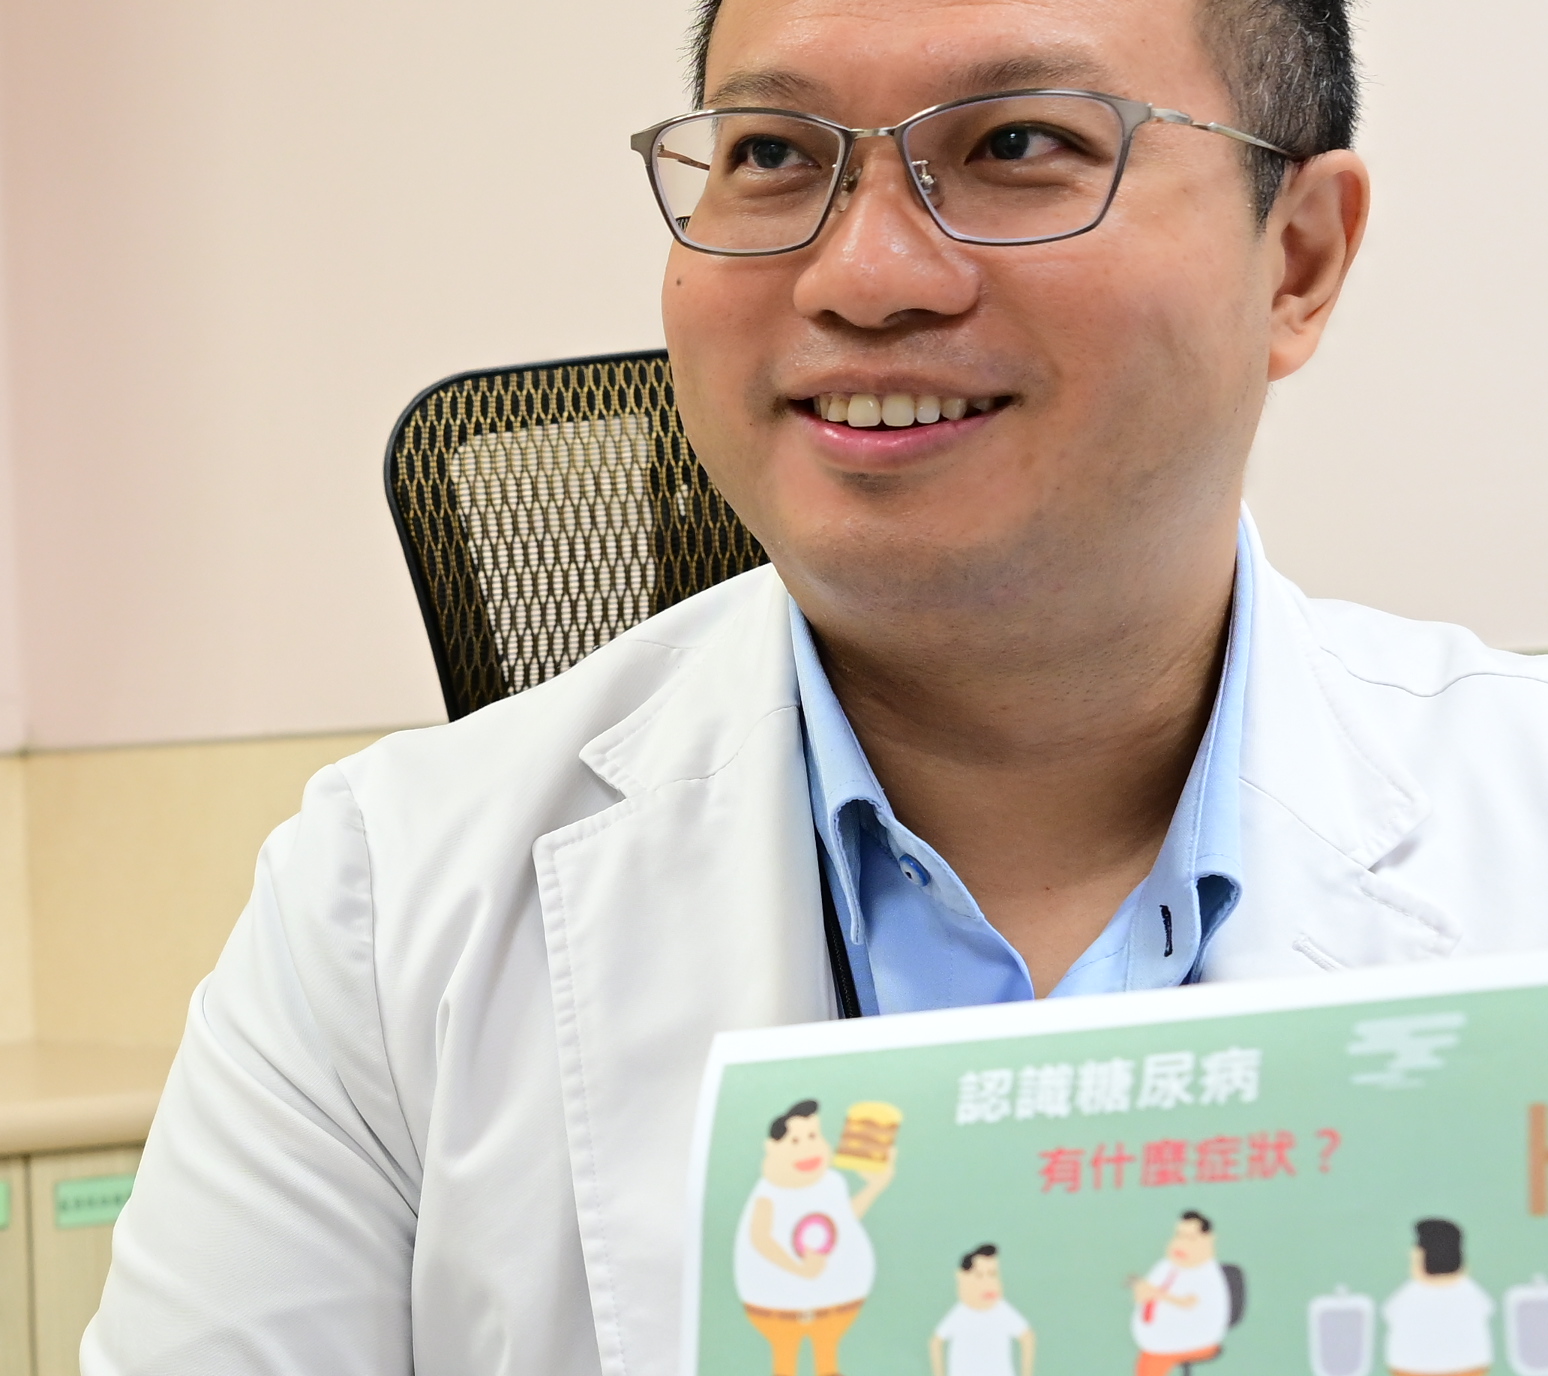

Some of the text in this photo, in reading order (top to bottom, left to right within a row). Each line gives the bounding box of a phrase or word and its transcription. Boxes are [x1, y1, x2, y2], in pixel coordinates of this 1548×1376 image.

[955, 1048, 1262, 1125] 認識糖尿病
[1037, 1128, 1342, 1194] 有什麼症狀？
